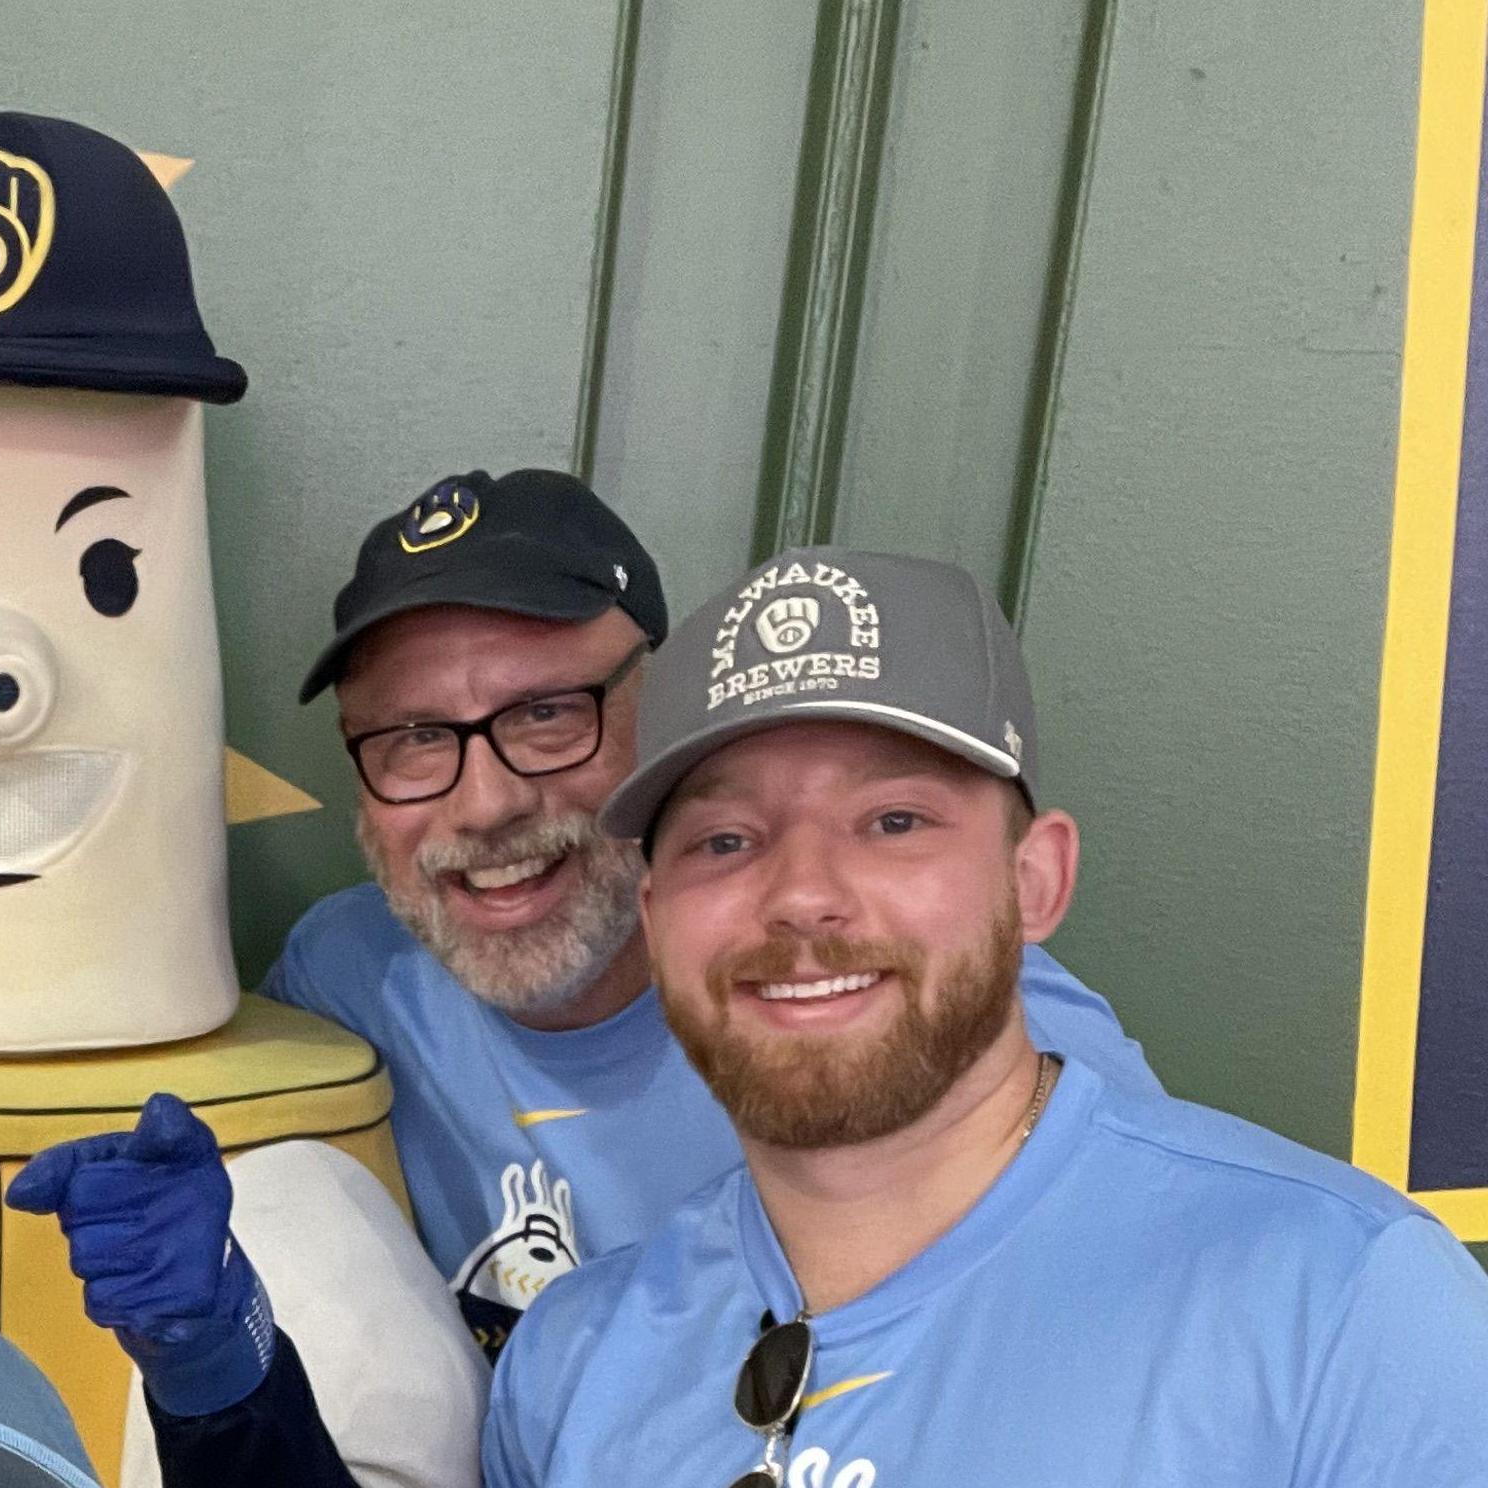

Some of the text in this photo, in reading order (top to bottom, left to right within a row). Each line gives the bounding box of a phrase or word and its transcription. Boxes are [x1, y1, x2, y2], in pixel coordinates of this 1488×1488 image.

[710, 562, 880, 678] MILWAUKEE
[707, 652, 881, 710] BREWERS
[743, 677, 839, 705] SINCE 1970
